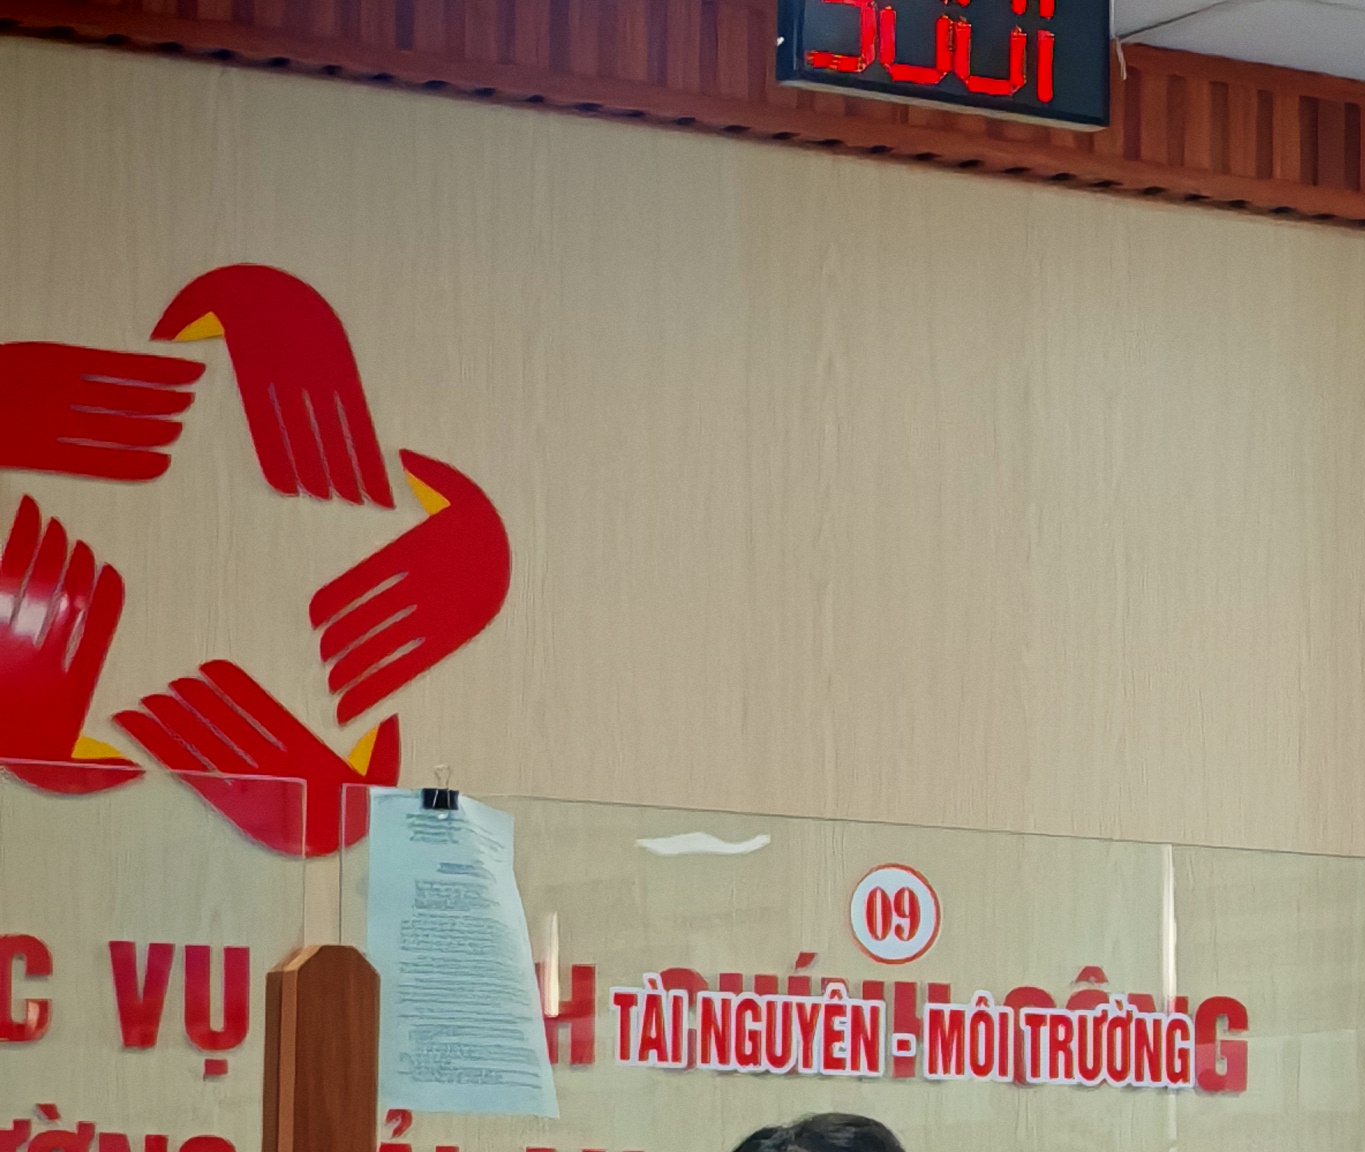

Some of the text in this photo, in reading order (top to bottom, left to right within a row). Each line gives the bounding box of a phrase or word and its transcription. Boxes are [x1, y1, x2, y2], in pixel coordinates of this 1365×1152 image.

[864, 886, 922, 943] 09
[108, 940, 250, 1077] VỤ
[613, 977, 683, 1064] TÀI
[700, 988, 880, 1073] NGUYÊN
[928, 996, 1009, 1078] MÔI
[1025, 998, 1191, 1084] TRƯỜNG
